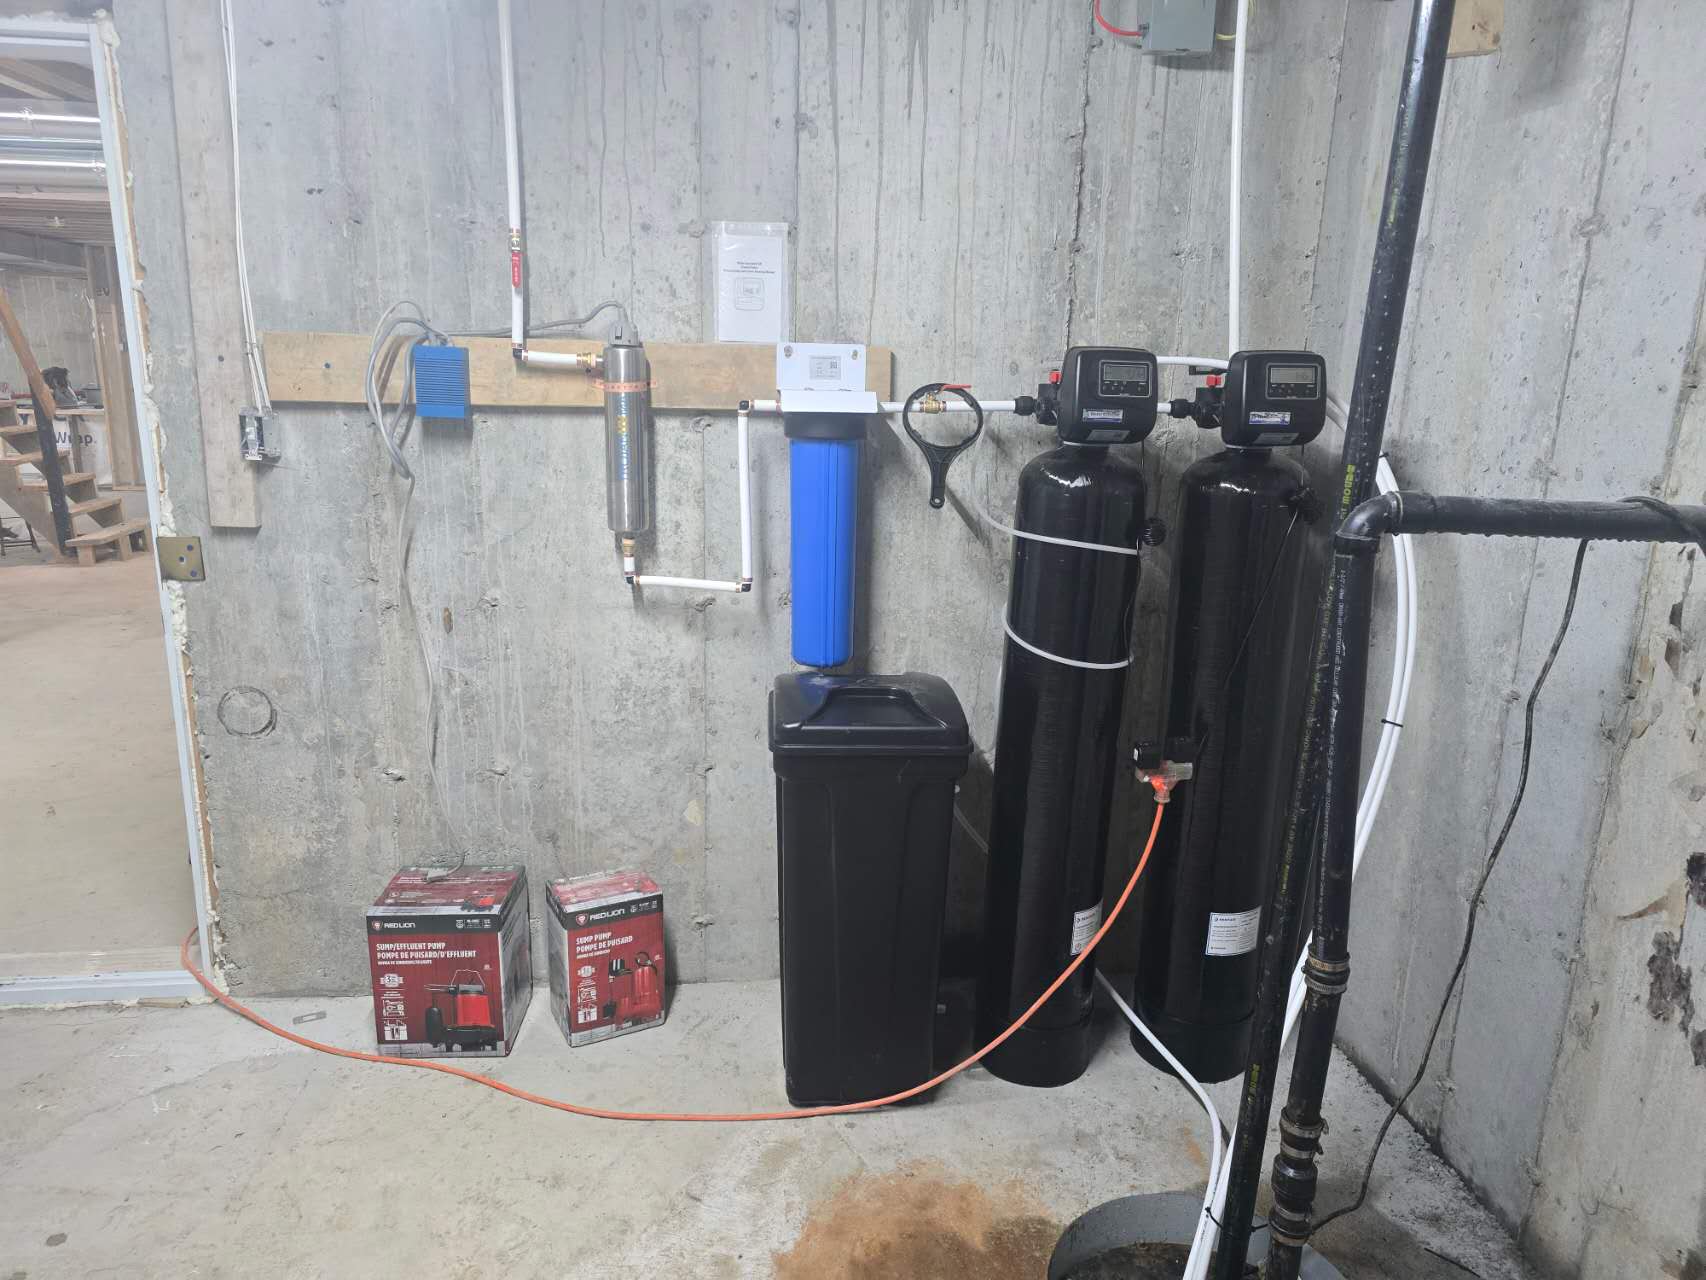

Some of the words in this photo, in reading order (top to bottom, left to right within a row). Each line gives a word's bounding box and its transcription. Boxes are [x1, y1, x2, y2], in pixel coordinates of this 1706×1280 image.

[576, 935, 593, 945] SUMP
[594, 931, 612, 941] PUMP
[376, 942, 426, 951] SUMP/EFFLUENT
[427, 942, 446, 950] PUMP
[576, 943, 598, 953] POMPE
[598, 941, 607, 949] DE
[607, 935, 633, 947] PUISARD
[377, 951, 399, 959] POMPE
[400, 951, 409, 959] DE
